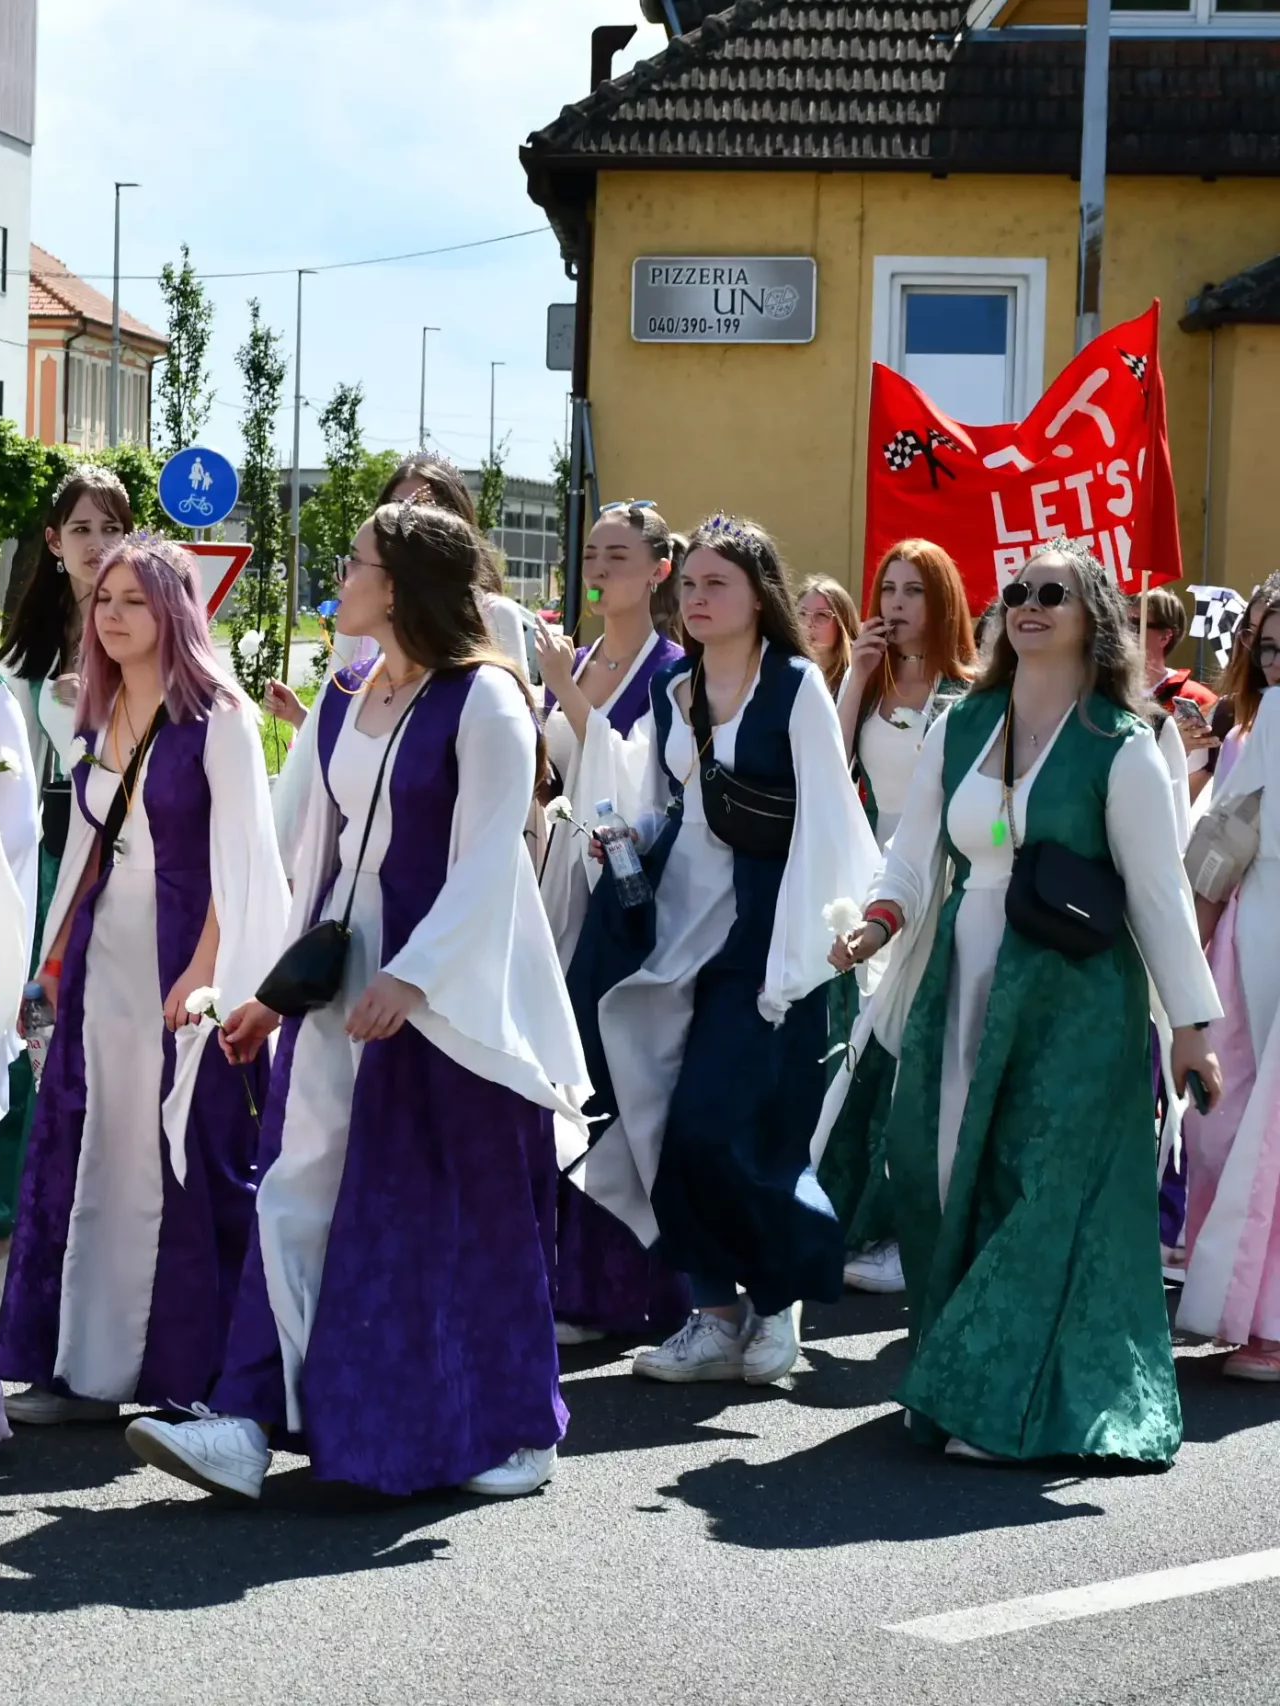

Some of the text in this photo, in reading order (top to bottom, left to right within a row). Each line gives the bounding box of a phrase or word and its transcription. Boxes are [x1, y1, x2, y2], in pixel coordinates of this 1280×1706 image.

[651, 267, 749, 285] PIZZERIA
[649, 317, 740, 334] 040/390-199
[990, 458, 1133, 545] LET'S
